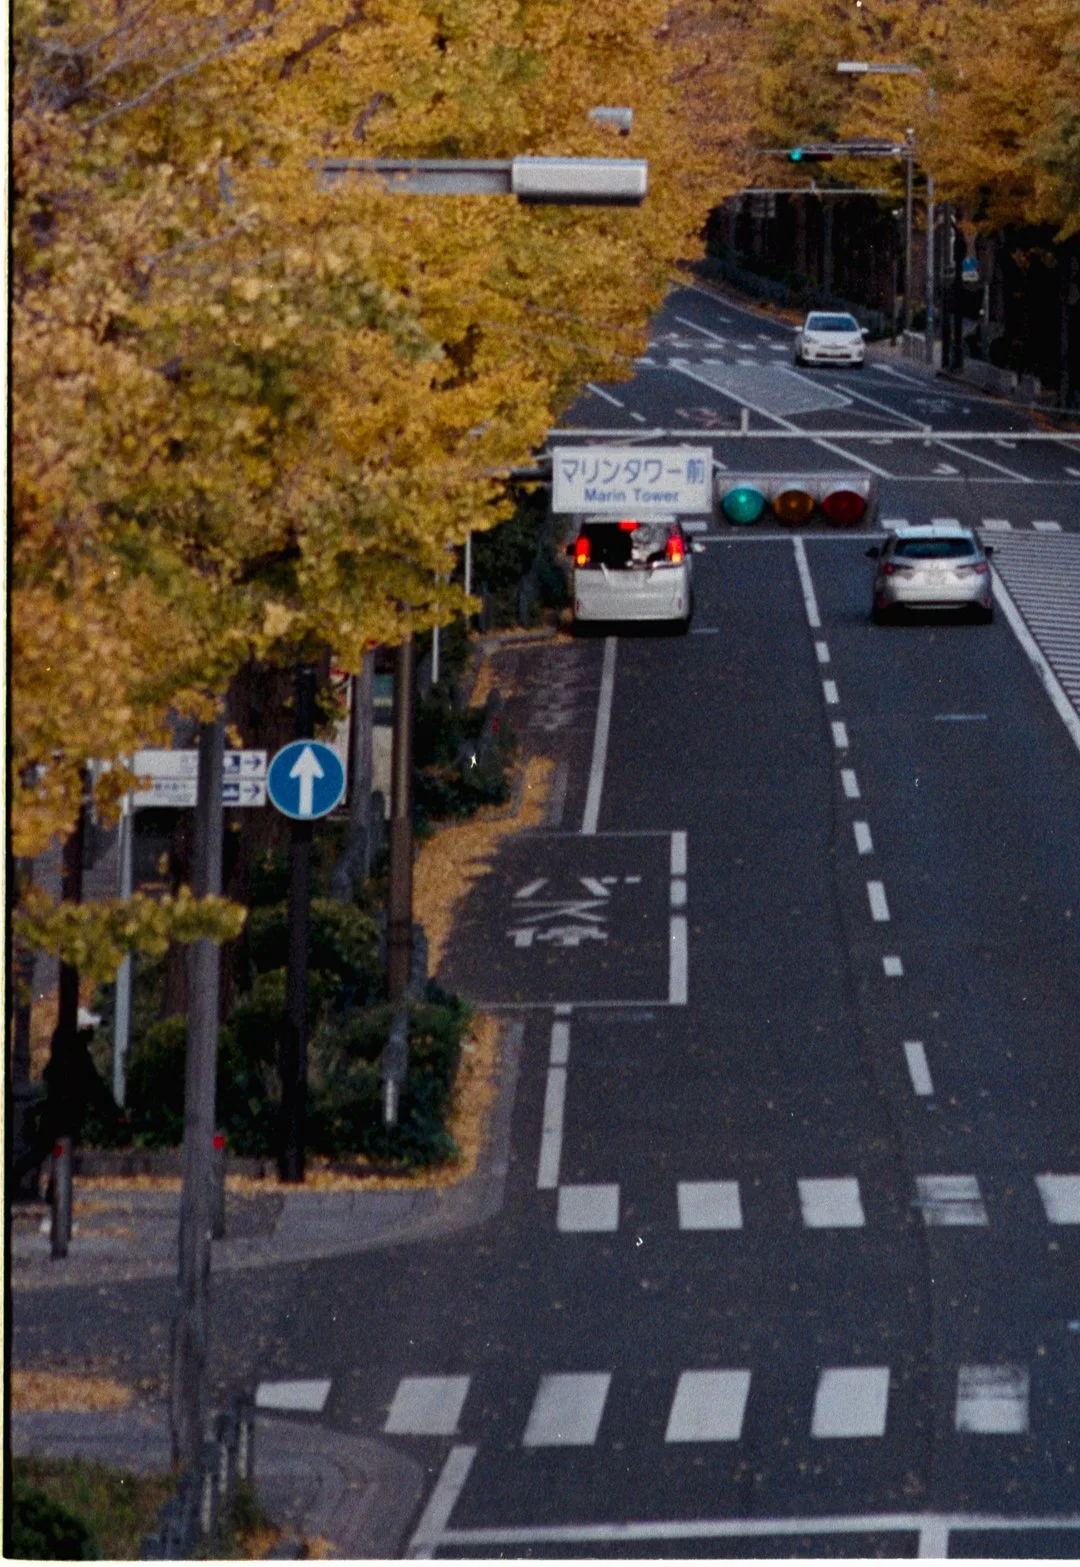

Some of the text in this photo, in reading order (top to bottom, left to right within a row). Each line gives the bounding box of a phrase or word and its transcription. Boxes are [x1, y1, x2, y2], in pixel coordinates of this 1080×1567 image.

[561, 458, 705, 484] マリンタワー前
[583, 487, 679, 502] Marin Tower
